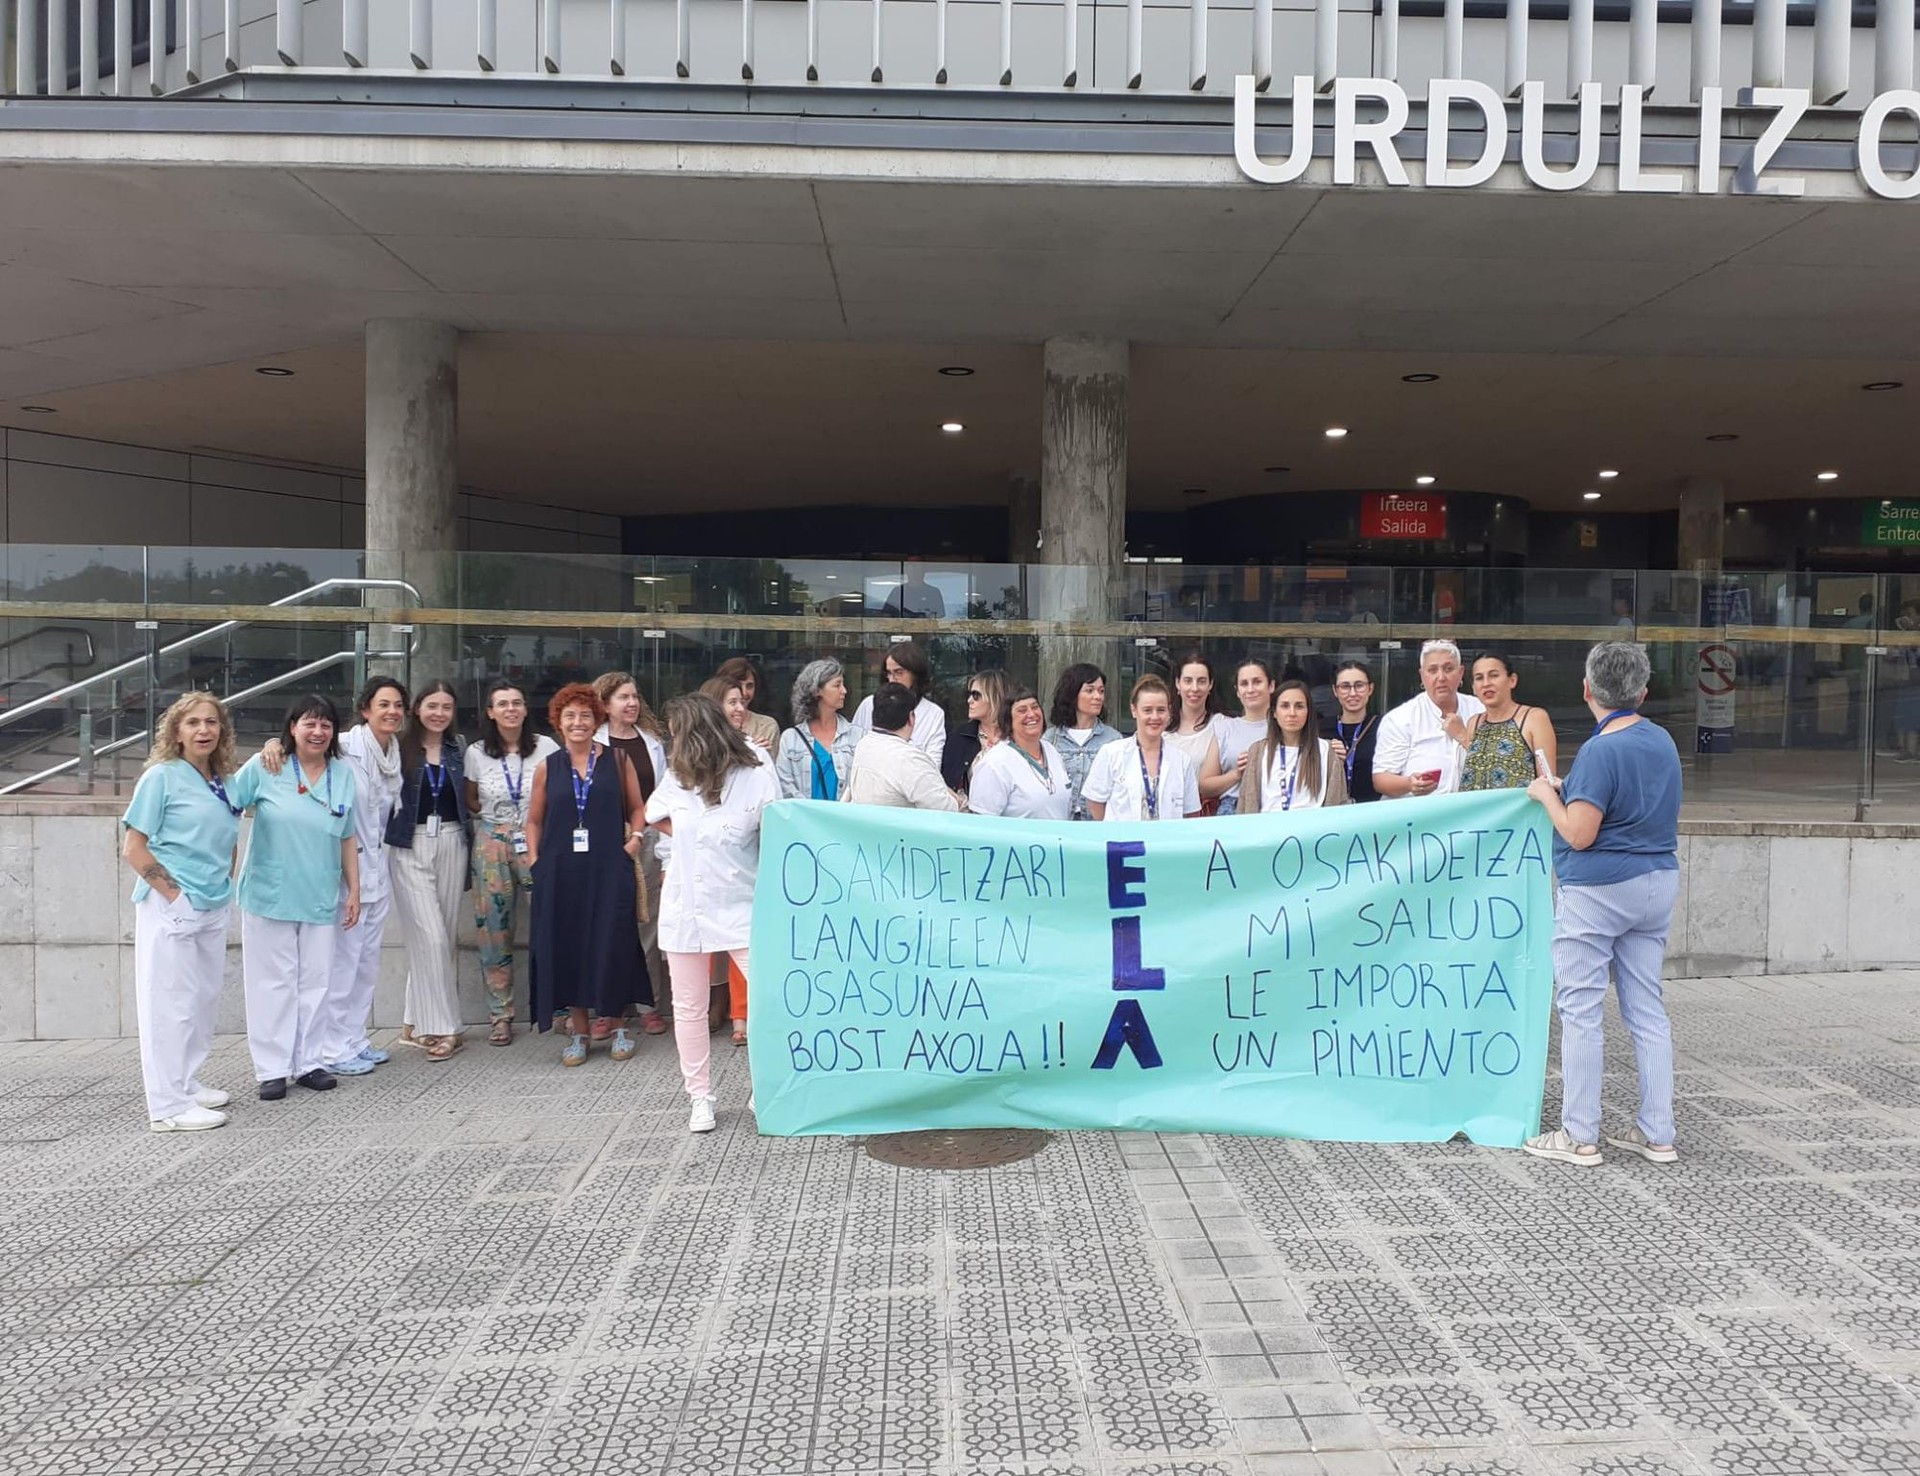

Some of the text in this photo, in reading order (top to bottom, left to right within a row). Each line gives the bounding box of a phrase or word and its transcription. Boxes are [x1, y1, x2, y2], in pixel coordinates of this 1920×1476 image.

[1233, 74, 1920, 200] URDULIZ O
[1380, 496, 1428, 512] Irteera
[1380, 518, 1426, 534] Salida
[1205, 838, 1237, 892] A
[1352, 896, 1524, 947] SALUD
[783, 969, 989, 1021] OSASUNA
[1225, 960, 1516, 1019] LE IMPORTA
[787, 1027, 886, 1072] BOST
[1212, 1030, 1278, 1072] UN
